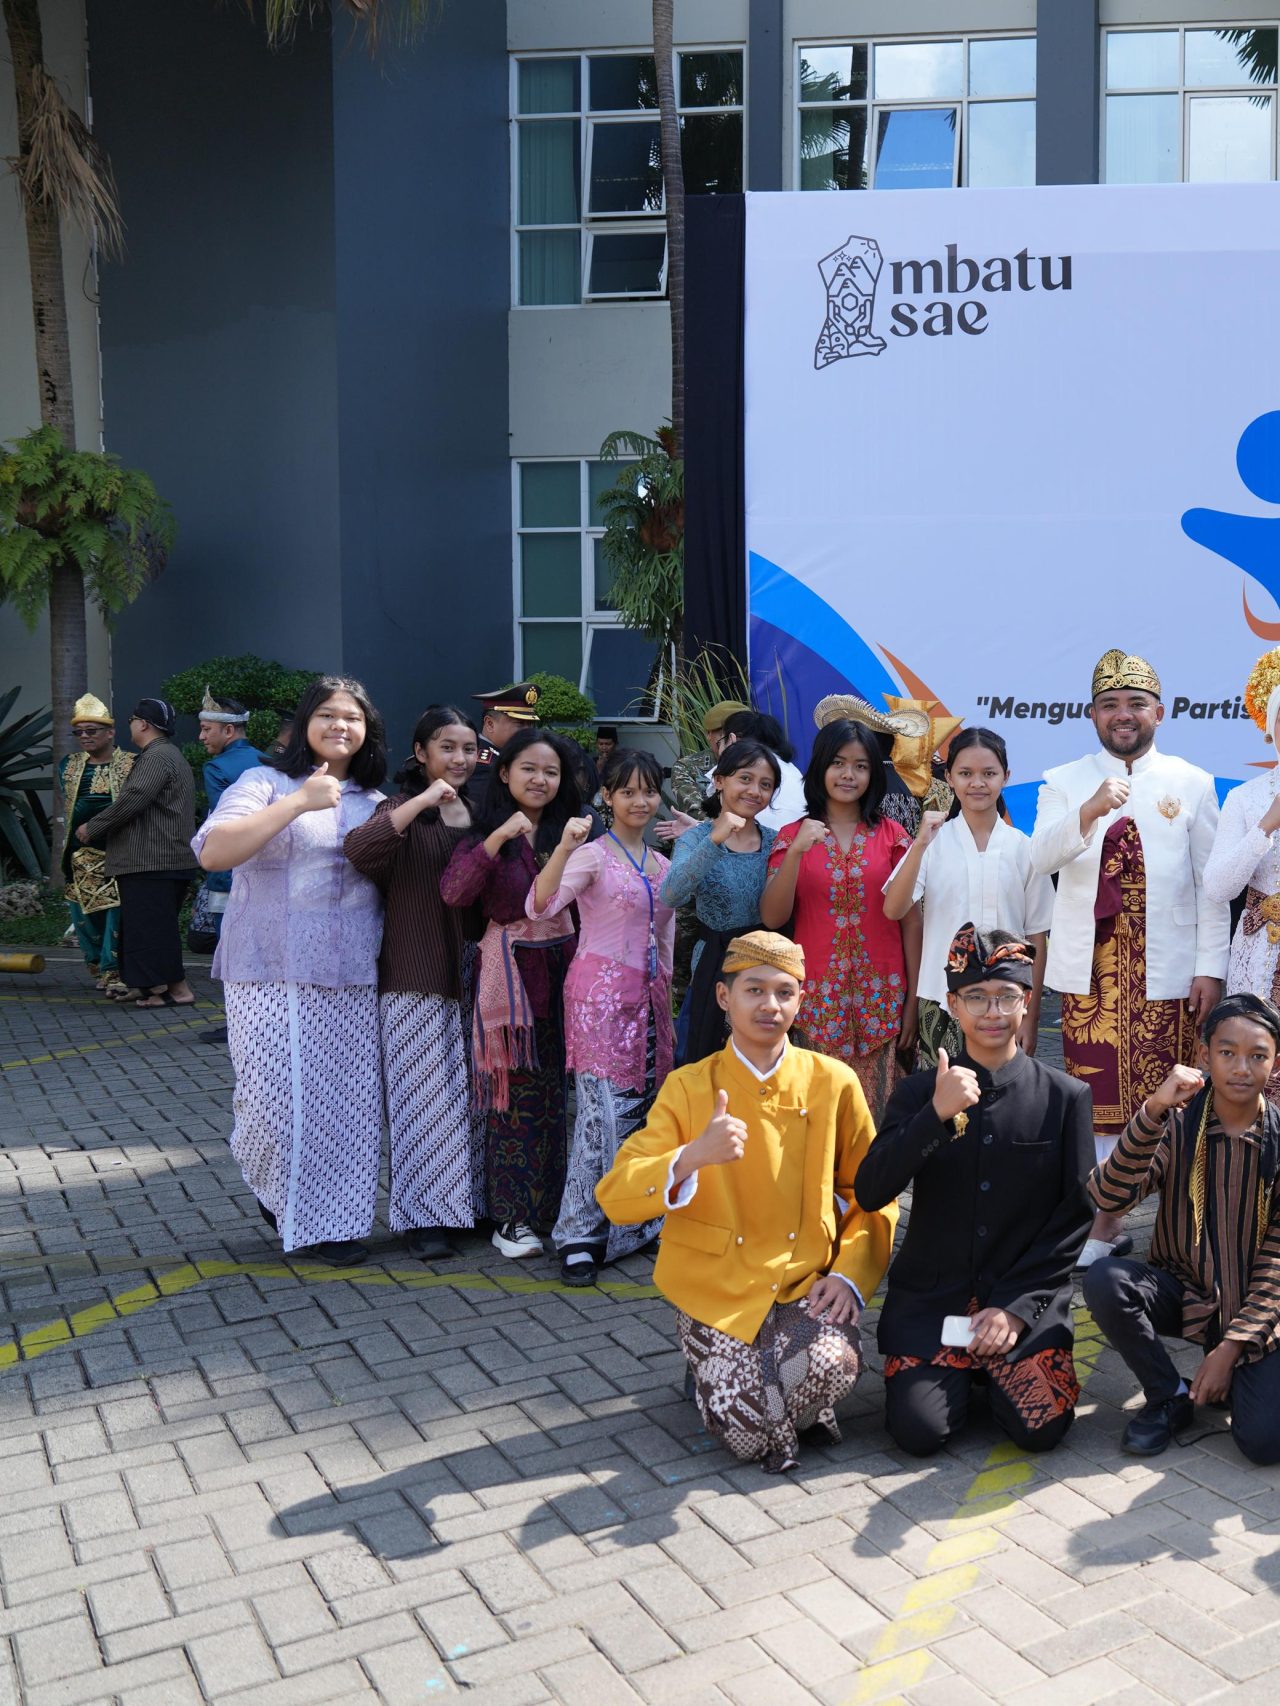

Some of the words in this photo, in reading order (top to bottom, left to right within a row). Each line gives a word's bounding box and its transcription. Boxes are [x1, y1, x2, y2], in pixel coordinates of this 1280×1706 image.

[889, 243, 1072, 294] mbatu
[889, 301, 989, 337] sae
[1171, 696, 1250, 720] Partis
